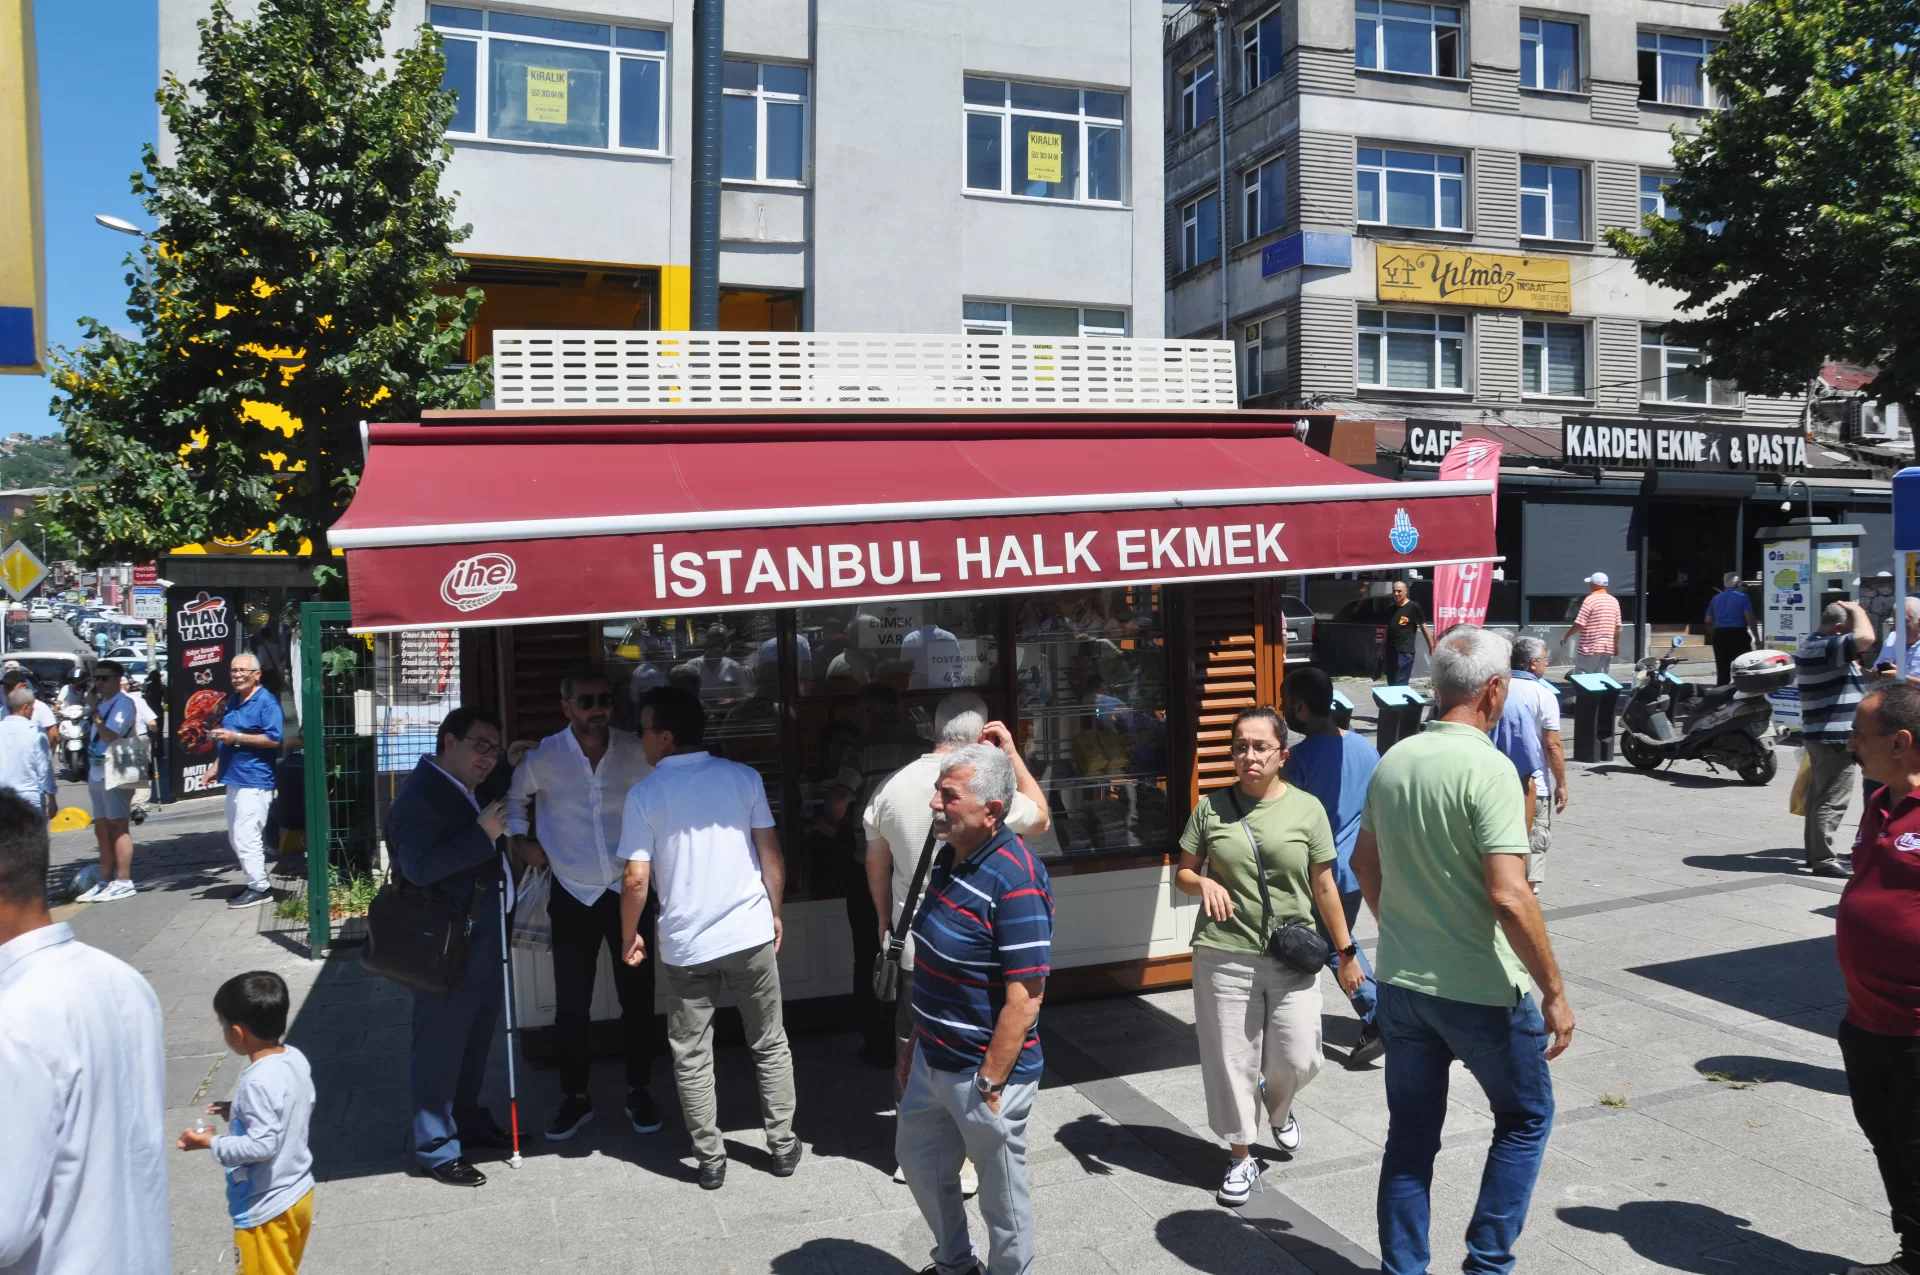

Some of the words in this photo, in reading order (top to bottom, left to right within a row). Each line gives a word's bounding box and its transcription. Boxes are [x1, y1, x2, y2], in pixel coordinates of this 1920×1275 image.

[1567, 424, 1652, 460] KARDEN
[1730, 437, 1743, 463] &
[1747, 434, 1809, 466] PASTA
[653, 540, 941, 599] İSTANBUL
[956, 530, 1102, 580] HALK
[1116, 522, 1290, 571] EKMEK
[452, 560, 509, 588] ihe
[178, 607, 226, 627] MAY
[869, 617, 913, 629] EKMEK
[179, 623, 228, 640] TAKO
[878, 634, 904, 645] VAR
[931, 655, 954, 664] TOST
